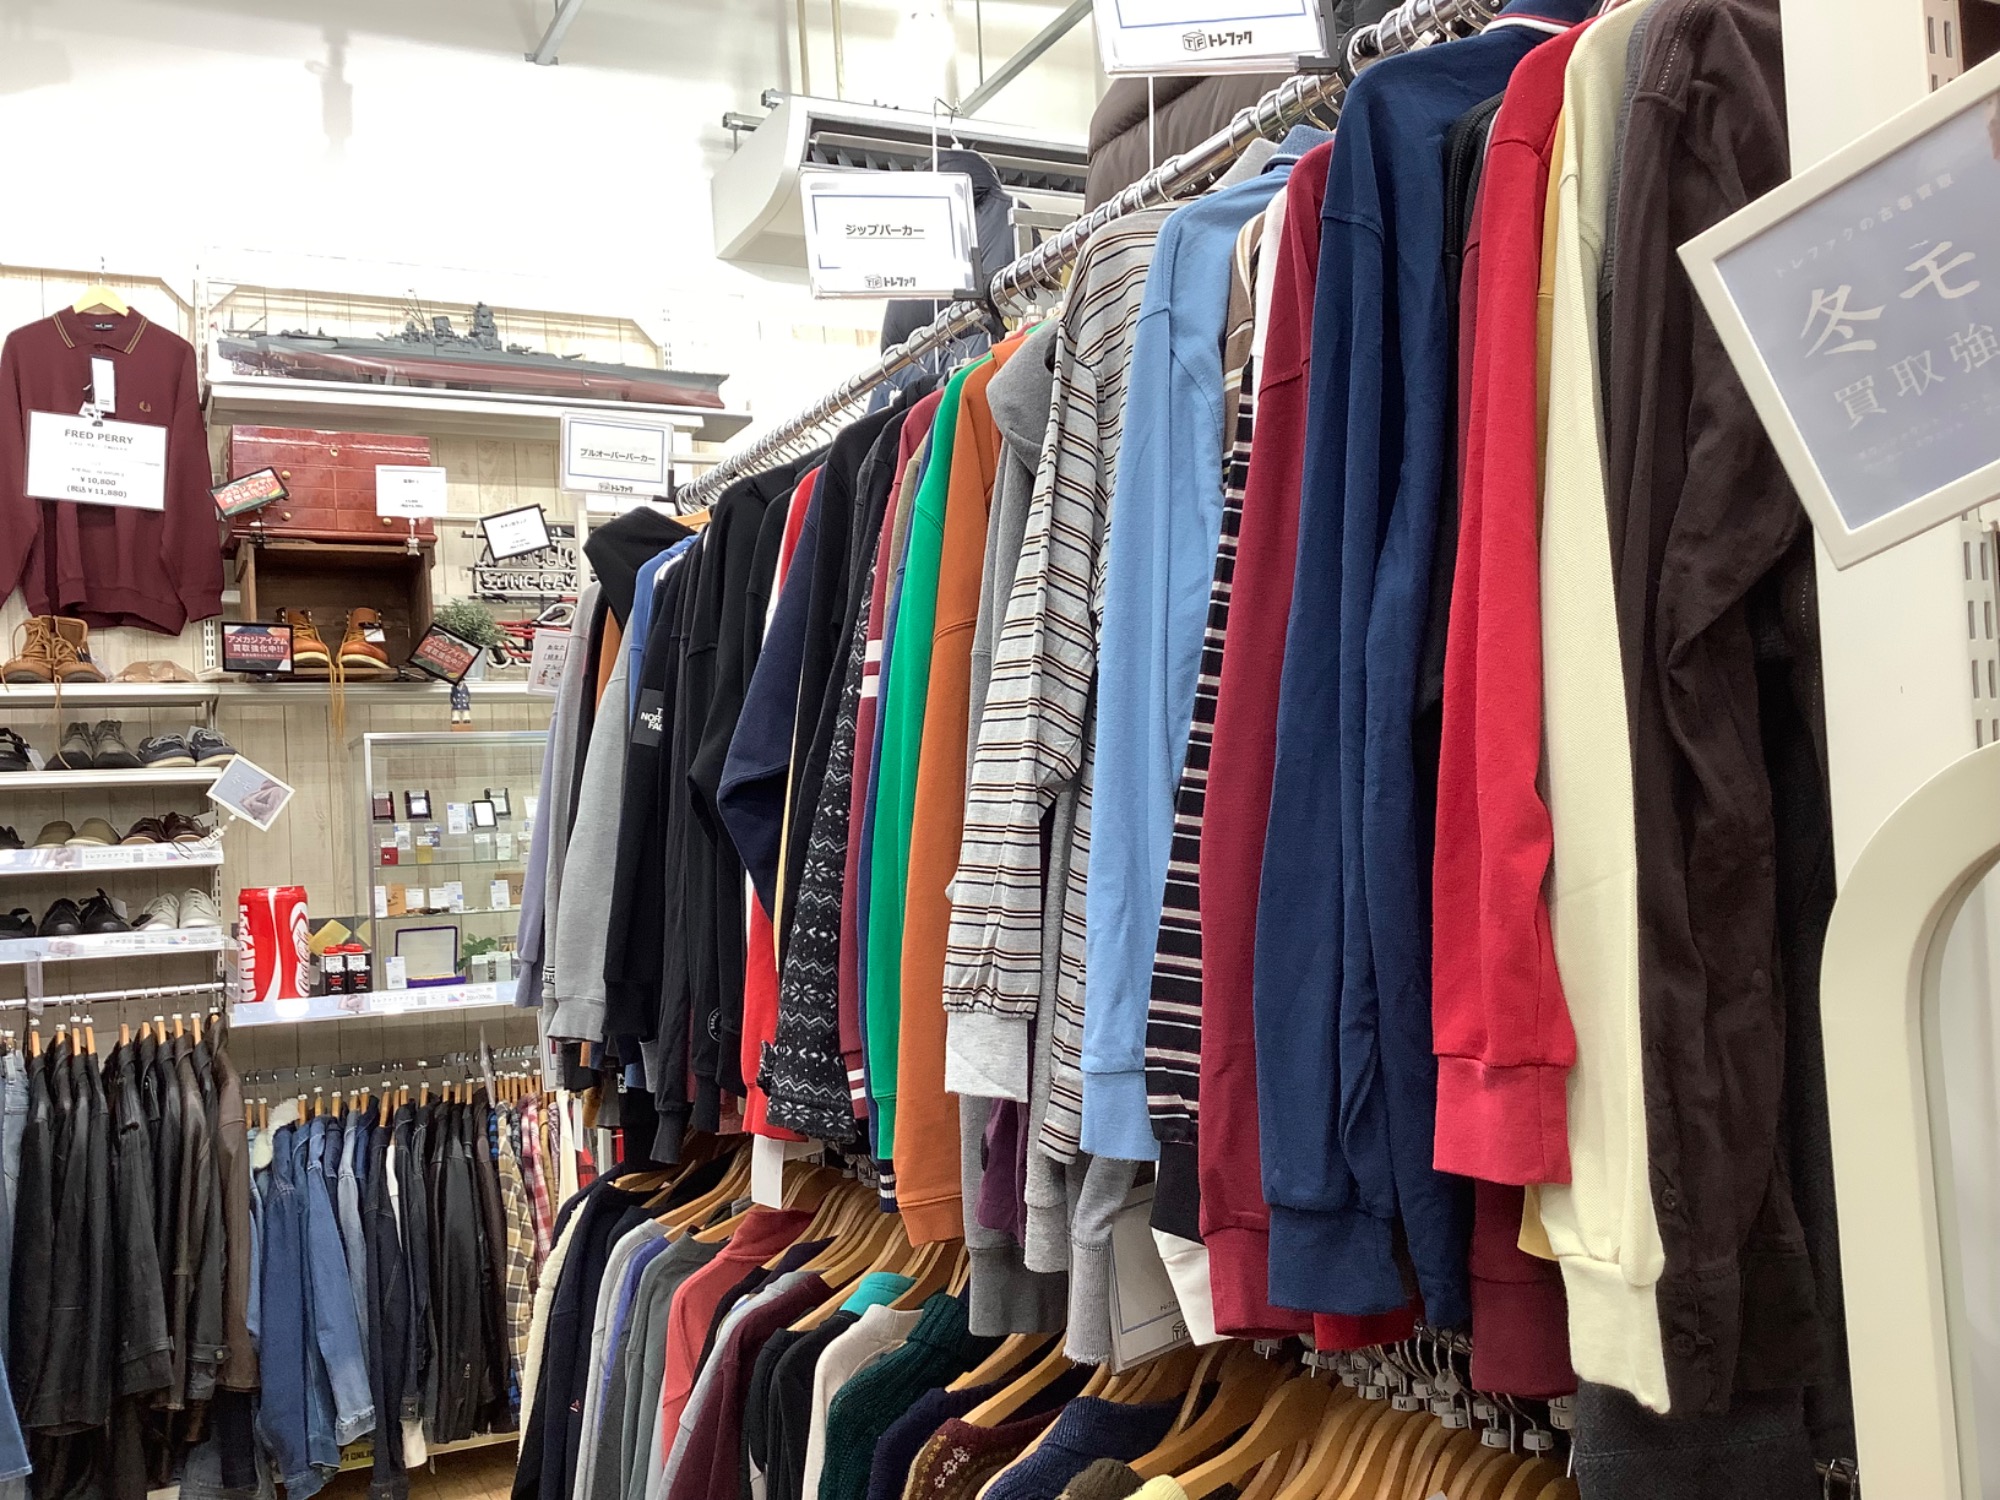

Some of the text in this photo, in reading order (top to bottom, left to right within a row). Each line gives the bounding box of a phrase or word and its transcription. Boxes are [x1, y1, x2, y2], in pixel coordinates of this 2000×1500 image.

[1208, 30, 1253, 48] トレファク
[884, 276, 916, 287] トレファク
[1833, 321, 2000, 431] 買取強
[64, 428, 134, 445] FRED PERRY
[227, 635, 288, 645] アメカジアイテム
[647, 721, 663, 732] FAC
[1353, 1377, 1359, 1387] S
[1376, 1388, 1382, 1398] S
[1398, 1399, 1407, 1409] M
[1455, 1416, 1463, 1426] L
[1487, 1434, 1494, 1445] L
[1538, 1438, 1546, 1448] L
